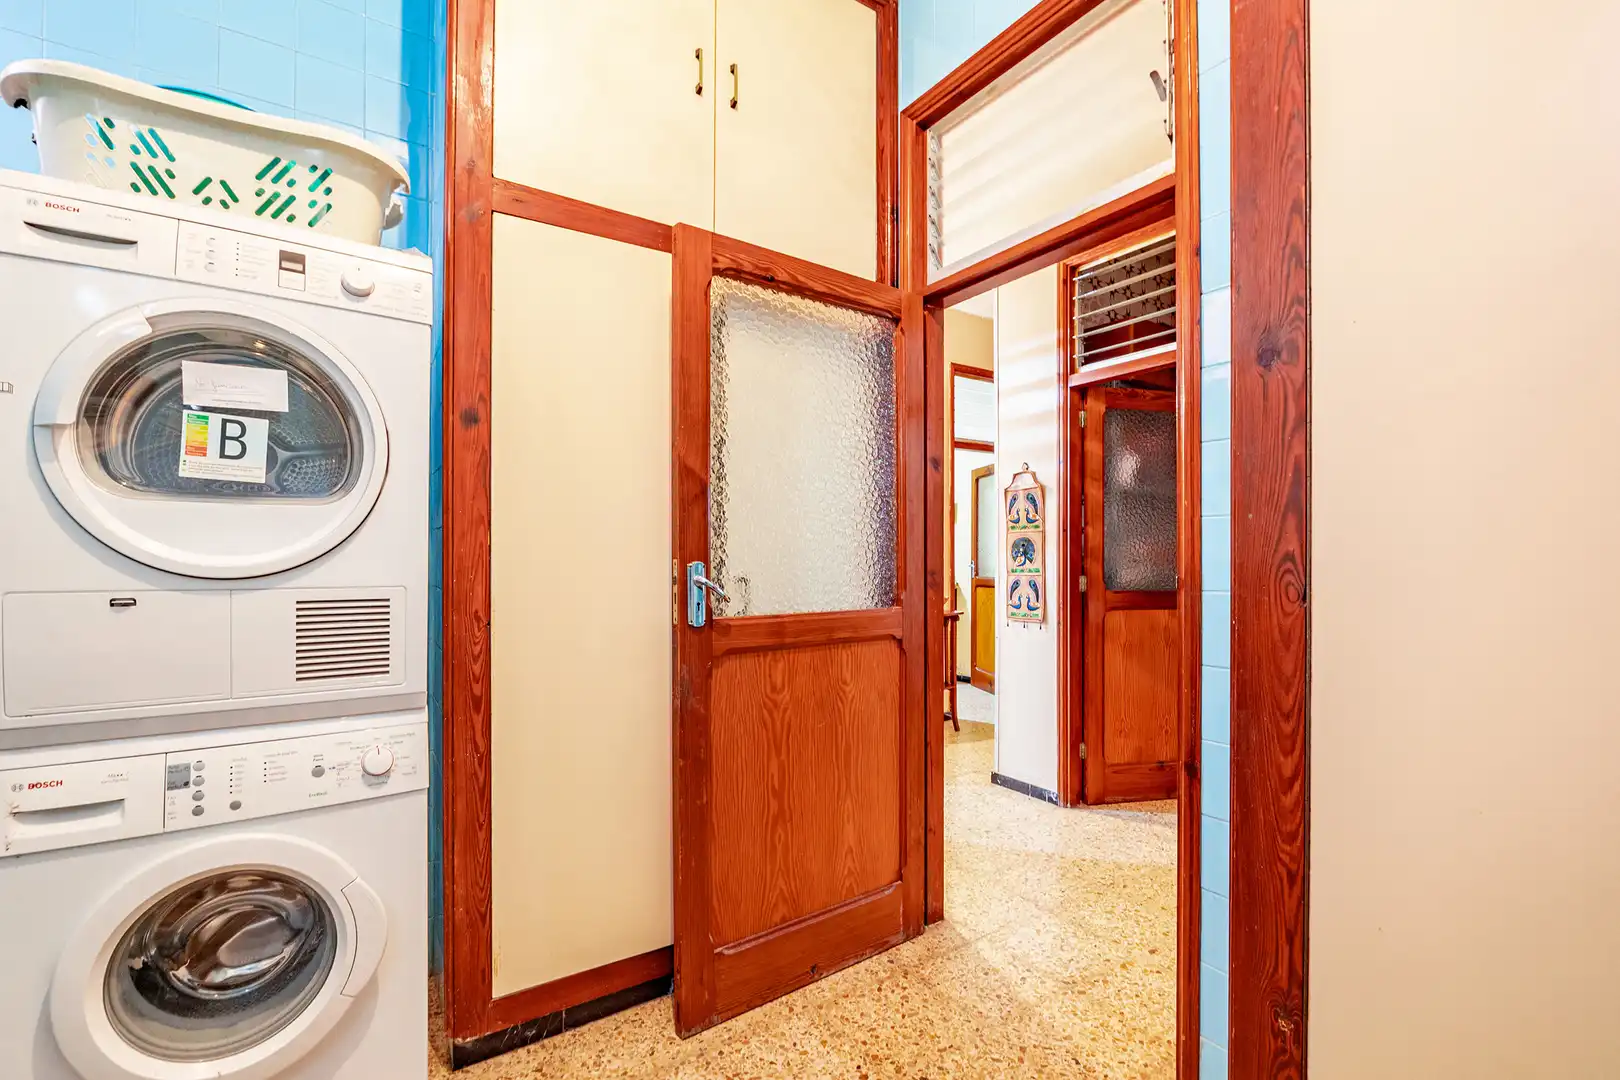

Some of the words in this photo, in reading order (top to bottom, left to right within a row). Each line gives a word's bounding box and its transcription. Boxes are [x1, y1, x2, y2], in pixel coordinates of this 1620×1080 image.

[44, 200, 80, 214] BOSCH
[219, 418, 248, 460] B
[27, 780, 64, 790] BOSCH
